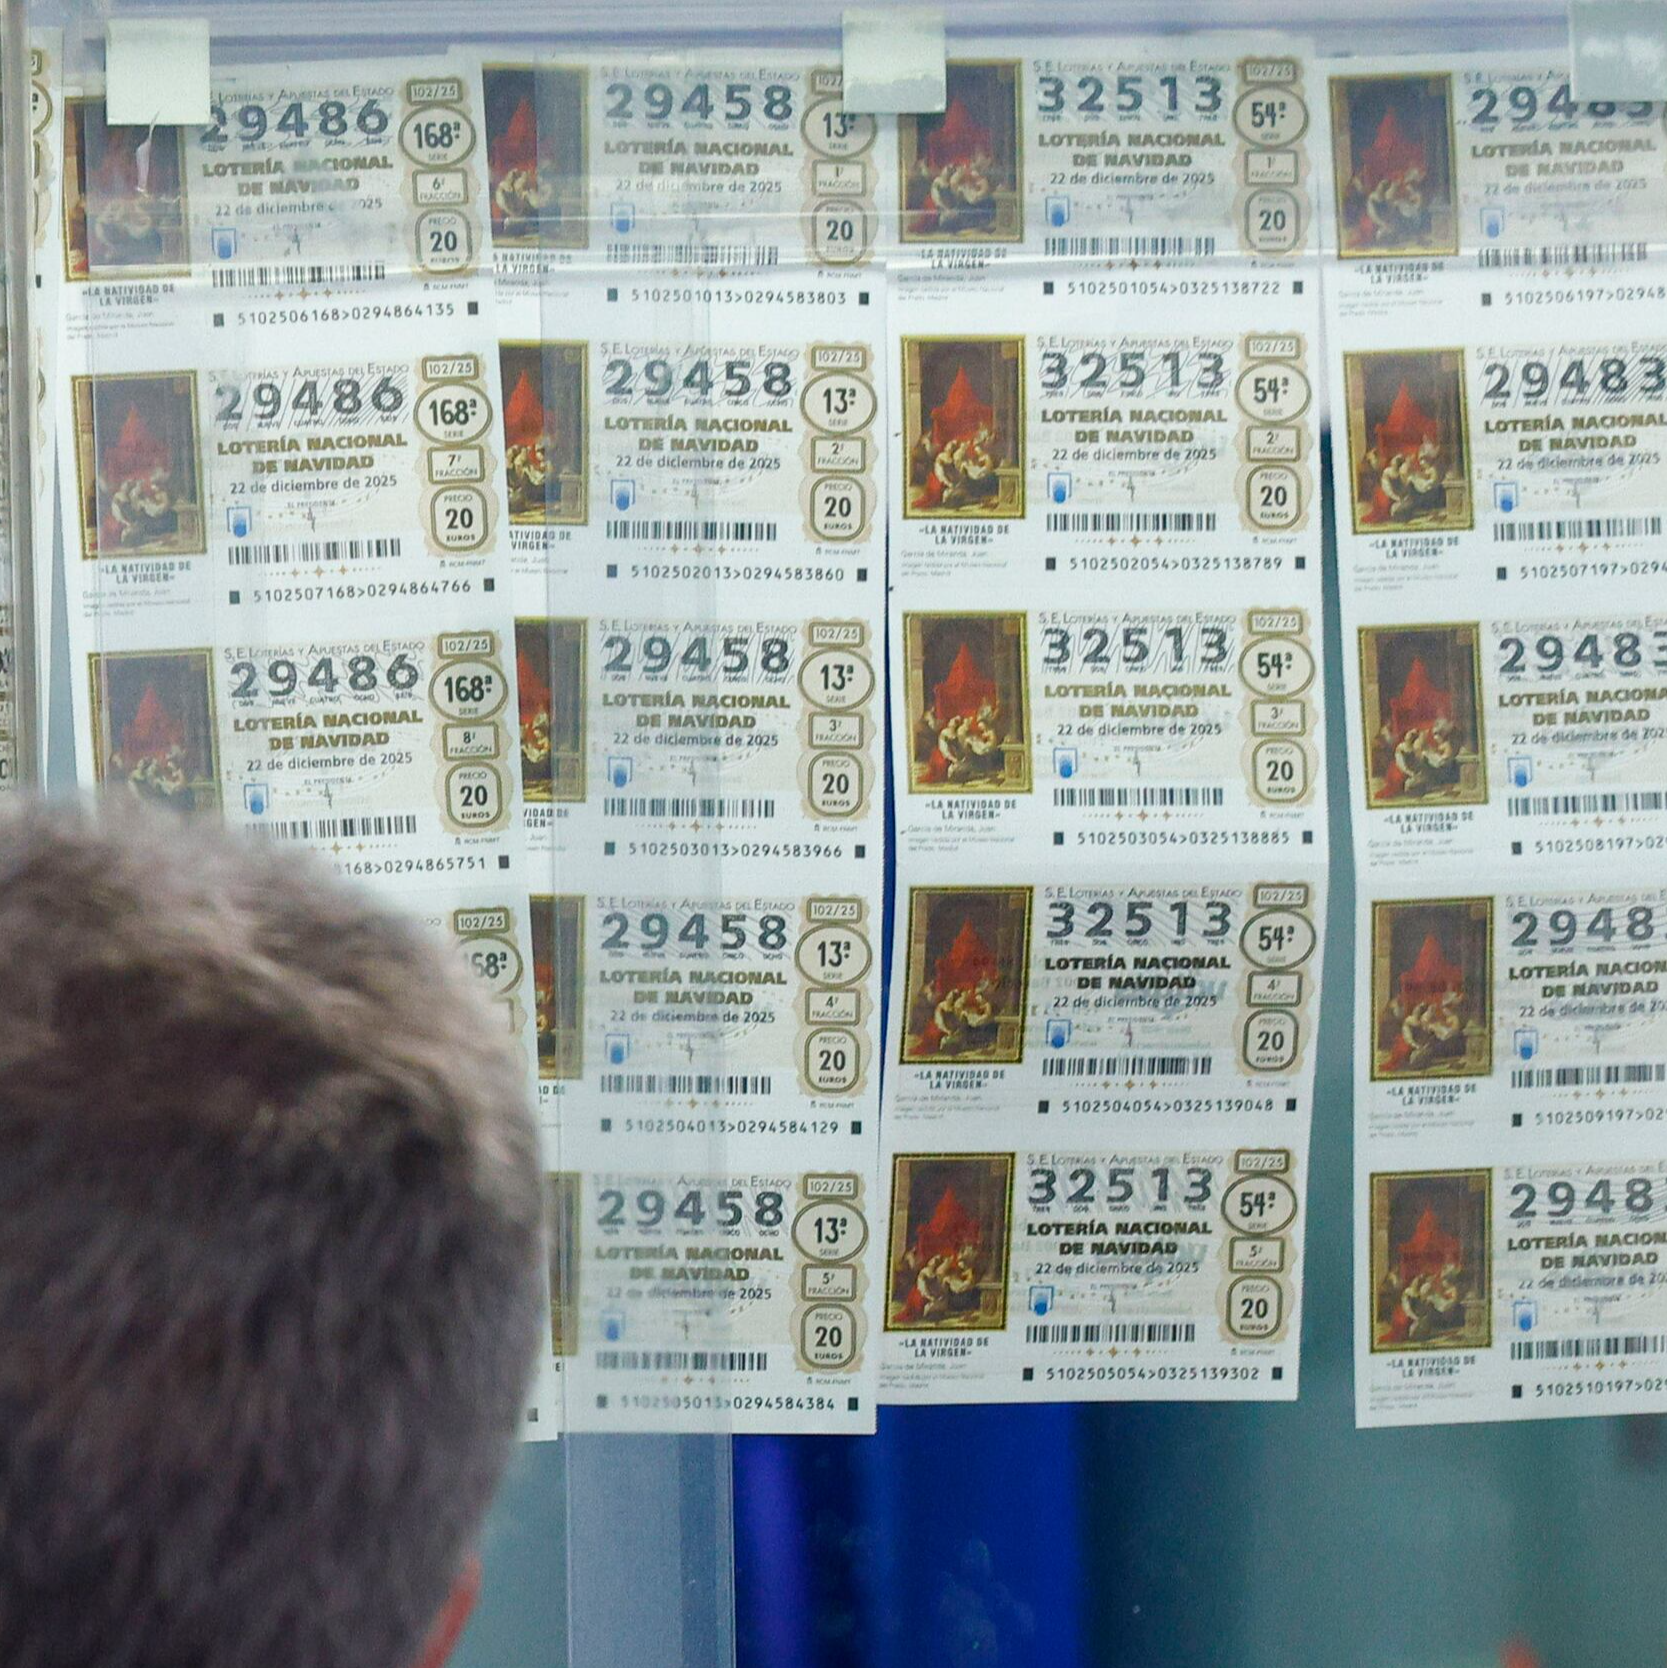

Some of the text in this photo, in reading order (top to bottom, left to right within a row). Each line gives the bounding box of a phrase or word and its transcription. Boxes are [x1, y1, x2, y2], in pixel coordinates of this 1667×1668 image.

[605, 83, 792, 120] 29458
[1038, 75, 1222, 113] 32513
[200, 99, 389, 144] 29486
[826, 219, 853, 241] 20
[1259, 210, 1286, 231] 20
[430, 230, 457, 252] 20
[427, 360, 472, 376] 102/25
[819, 350, 860, 364] 102/25
[605, 359, 792, 397] 29458
[1042, 352, 1224, 390] 32513
[215, 378, 403, 424] 29486
[605, 414, 792, 433] LOTERÍA NACIONAL
[1042, 406, 1227, 424] LOTERÍA NACIONAL
[639, 437, 758, 452] DE NAVIDAD
[1075, 429, 1194, 443] DE NAVIDAD
[1261, 486, 1287, 506] 20
[825, 497, 851, 518] 20
[445, 508, 473, 531] 20
[444, 637, 488, 652] 102/25
[604, 635, 790, 674] 29458
[1044, 627, 1228, 666] 32513
[232, 654, 418, 698] 29486
[1499, 685, 1578, 707] LOTERÍA
[234, 709, 422, 733] LOTERÍA NACIONAL
[1534, 709, 1650, 726] DE NAVIDAD
[269, 732, 389, 751] DE NAVIDAD
[1266, 760, 1293, 781] 20
[823, 774, 849, 795] 20
[460, 785, 488, 807] 20
[813, 904, 856, 918] 102/25
[1047, 901, 1231, 938] 32513
[601, 913, 787, 949] 29458
[1046, 953, 1231, 971] LOTERÍA NACIONAL
[1509, 960, 1588, 980] LOTERÍA
[1077, 975, 1196, 989] DE NAVIDAD
[1542, 982, 1659, 998] DE NAVIDAD
[1257, 1030, 1285, 1052] 20
[819, 1049, 846, 1071] 20
[810, 1181, 852, 1194] 102/25
[1028, 1168, 1212, 1204] 32513
[597, 1190, 783, 1226] 29458
[1241, 1299, 1268, 1319] 20
[815, 1326, 843, 1348] 20
